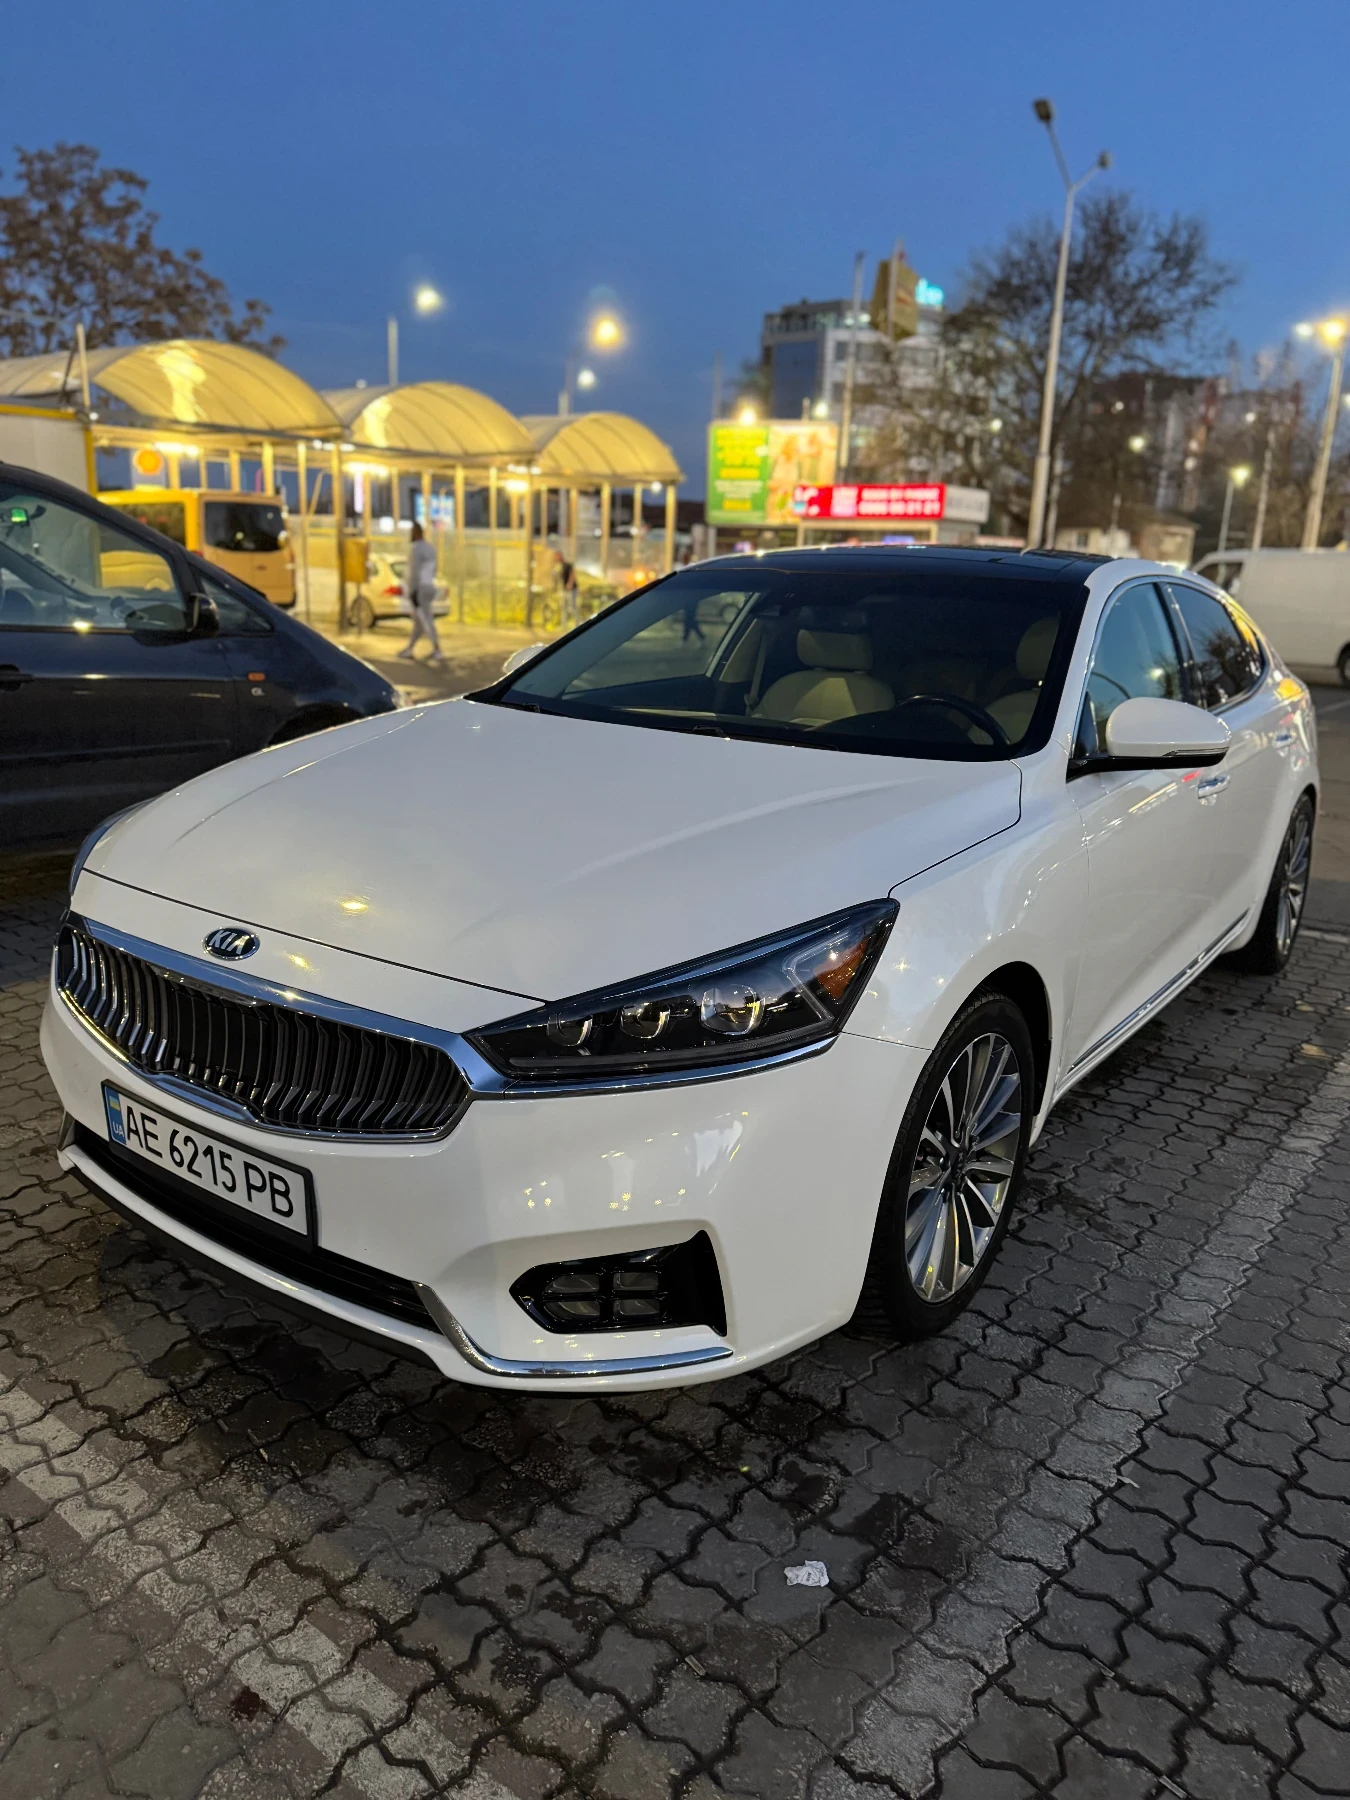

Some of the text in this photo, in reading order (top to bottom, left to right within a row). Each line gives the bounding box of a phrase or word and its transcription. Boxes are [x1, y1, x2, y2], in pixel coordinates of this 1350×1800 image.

[208, 930, 249, 954] KIA
[113, 1121, 125, 1138] UA
[127, 1105, 294, 1218] AE 6215 PB
